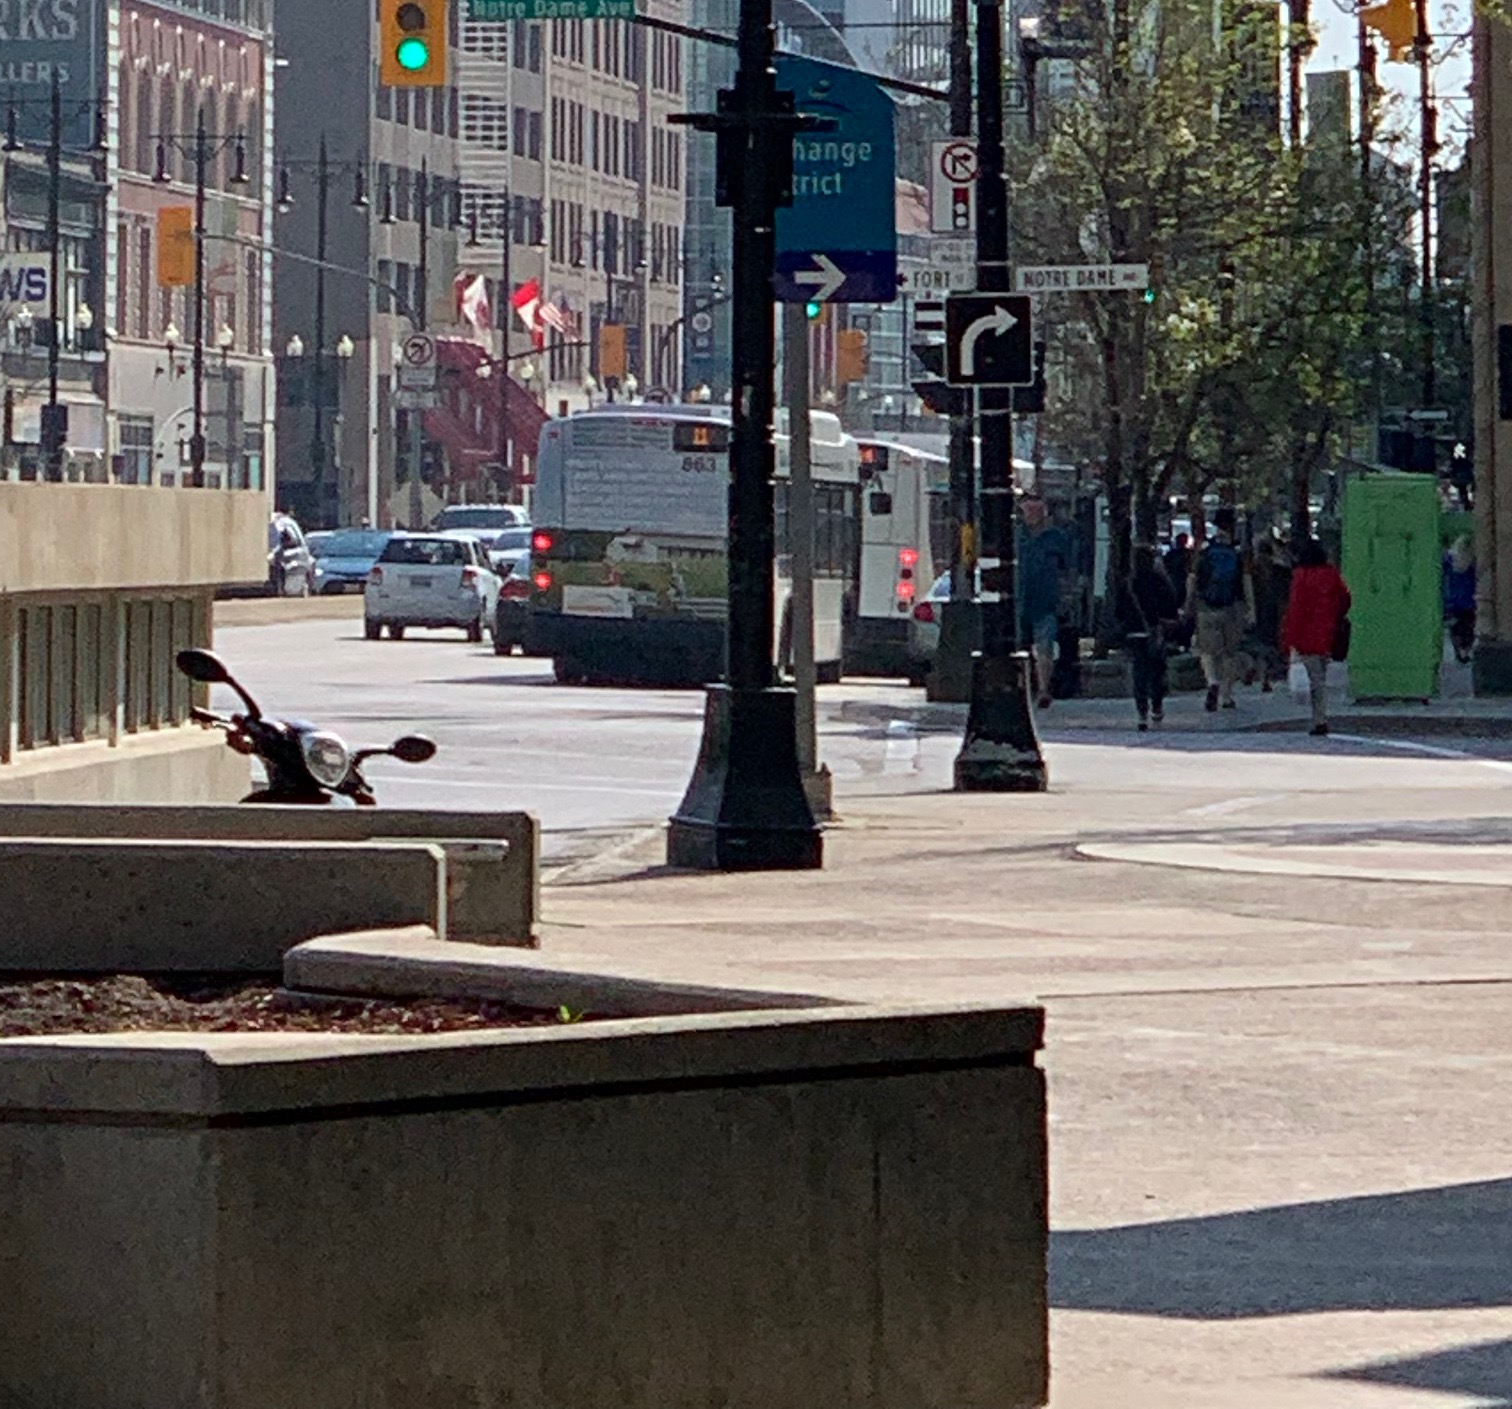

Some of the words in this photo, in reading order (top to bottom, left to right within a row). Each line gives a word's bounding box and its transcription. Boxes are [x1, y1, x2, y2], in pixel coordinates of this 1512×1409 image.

[473, 0, 526, 17] Notre
[534, 0, 589, 17] Dame
[597, 0, 632, 16] Ave
[792, 139, 873, 168] hange
[792, 171, 843, 195] trict
[913, 271, 951, 289] FORT
[1023, 270, 1070, 289] NOTRE
[1076, 268, 1116, 287] DAME
